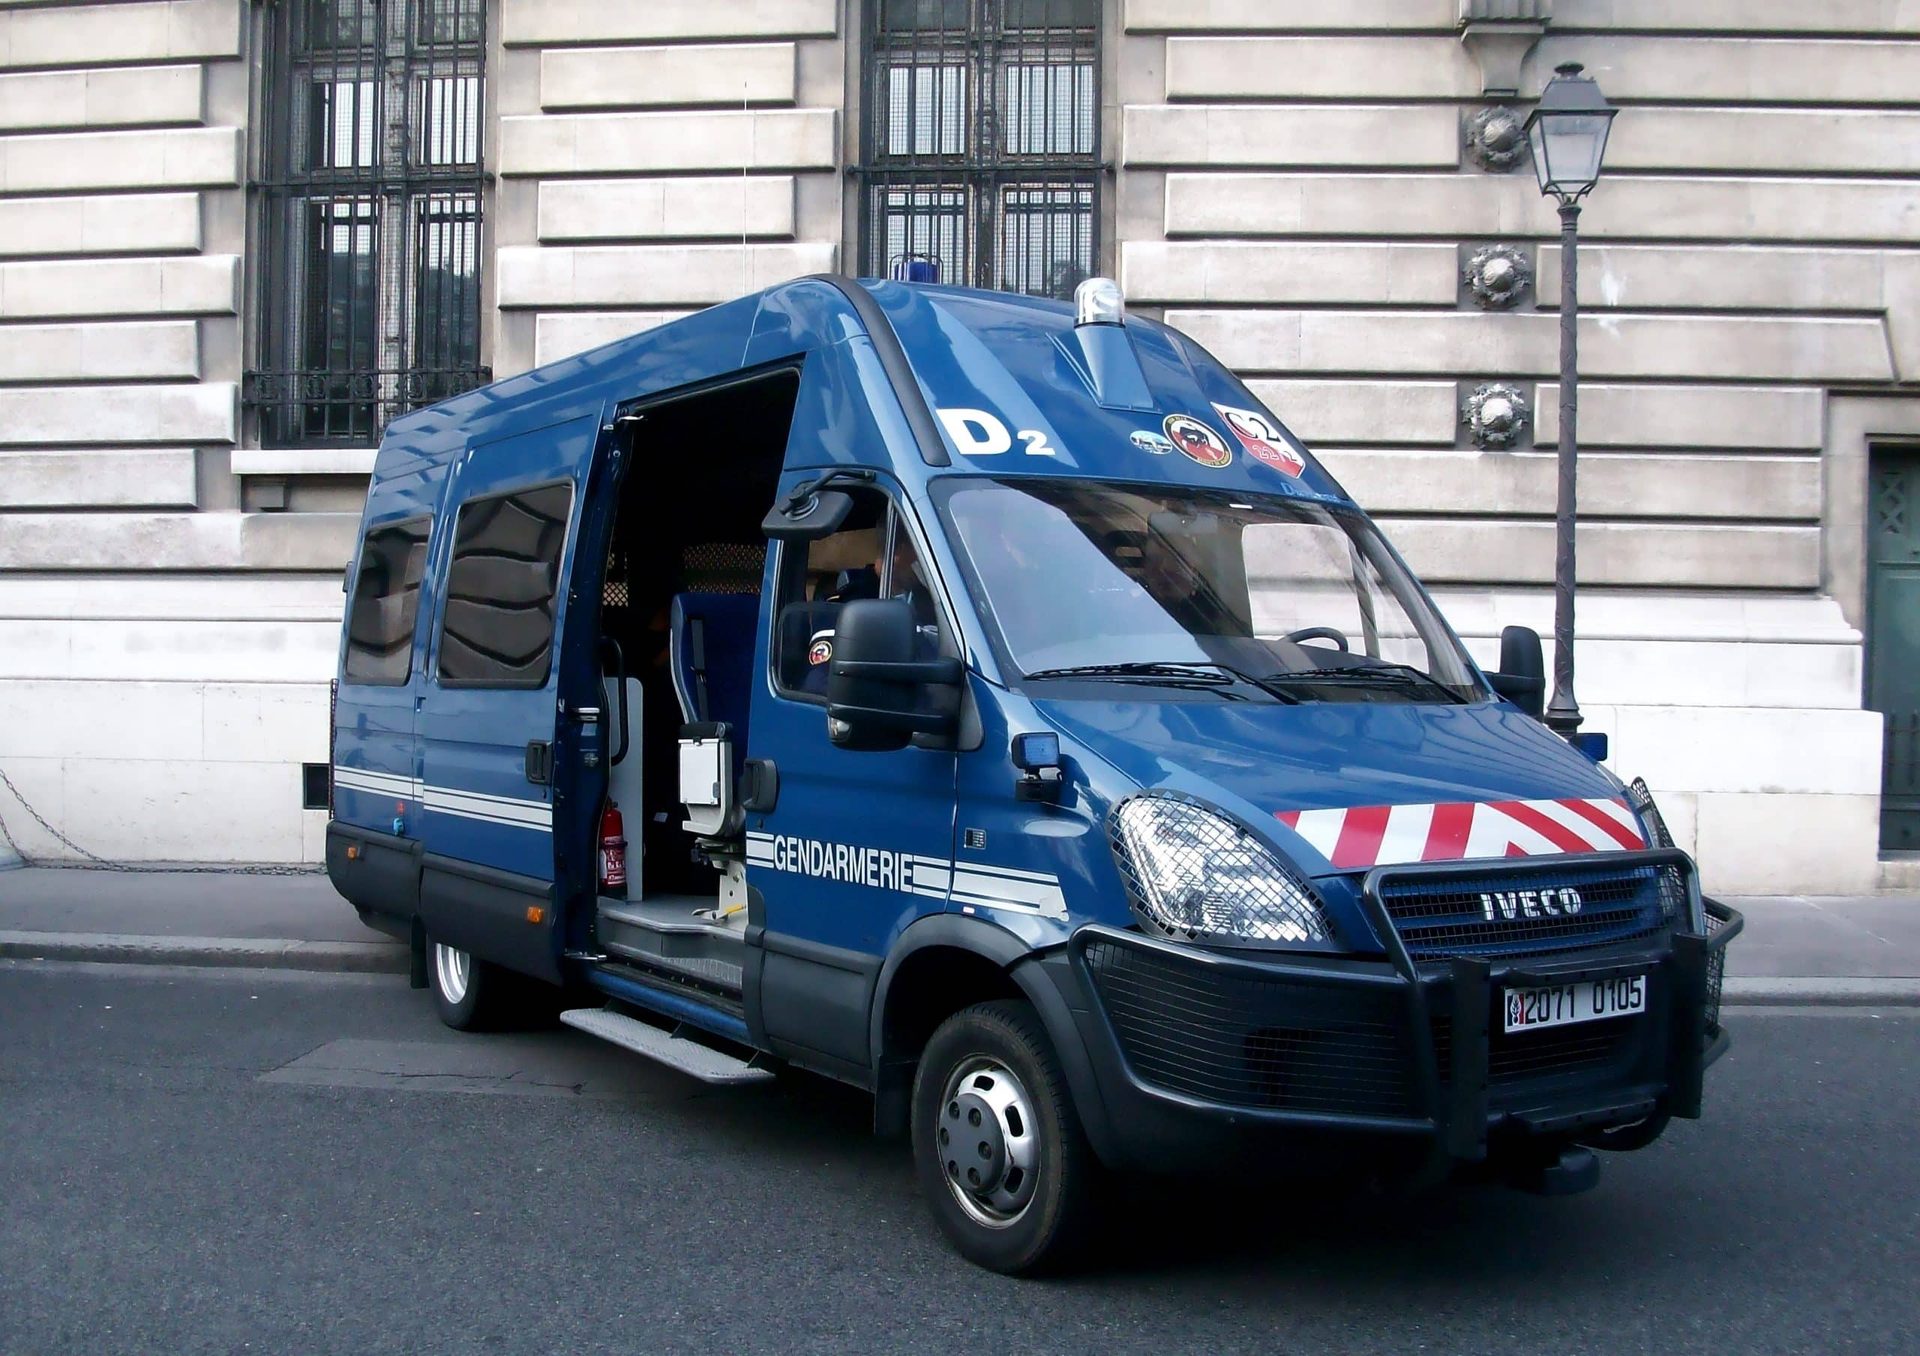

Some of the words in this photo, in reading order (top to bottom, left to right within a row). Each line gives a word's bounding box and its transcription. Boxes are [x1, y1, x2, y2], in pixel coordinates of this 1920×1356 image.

[936, 408, 1056, 455] D2
[773, 835, 914, 893] GENDARMERIE
[1480, 887, 1583, 921] IVECO
[1524, 985, 1575, 1025] 2071
[1592, 978, 1641, 1014] 0105
